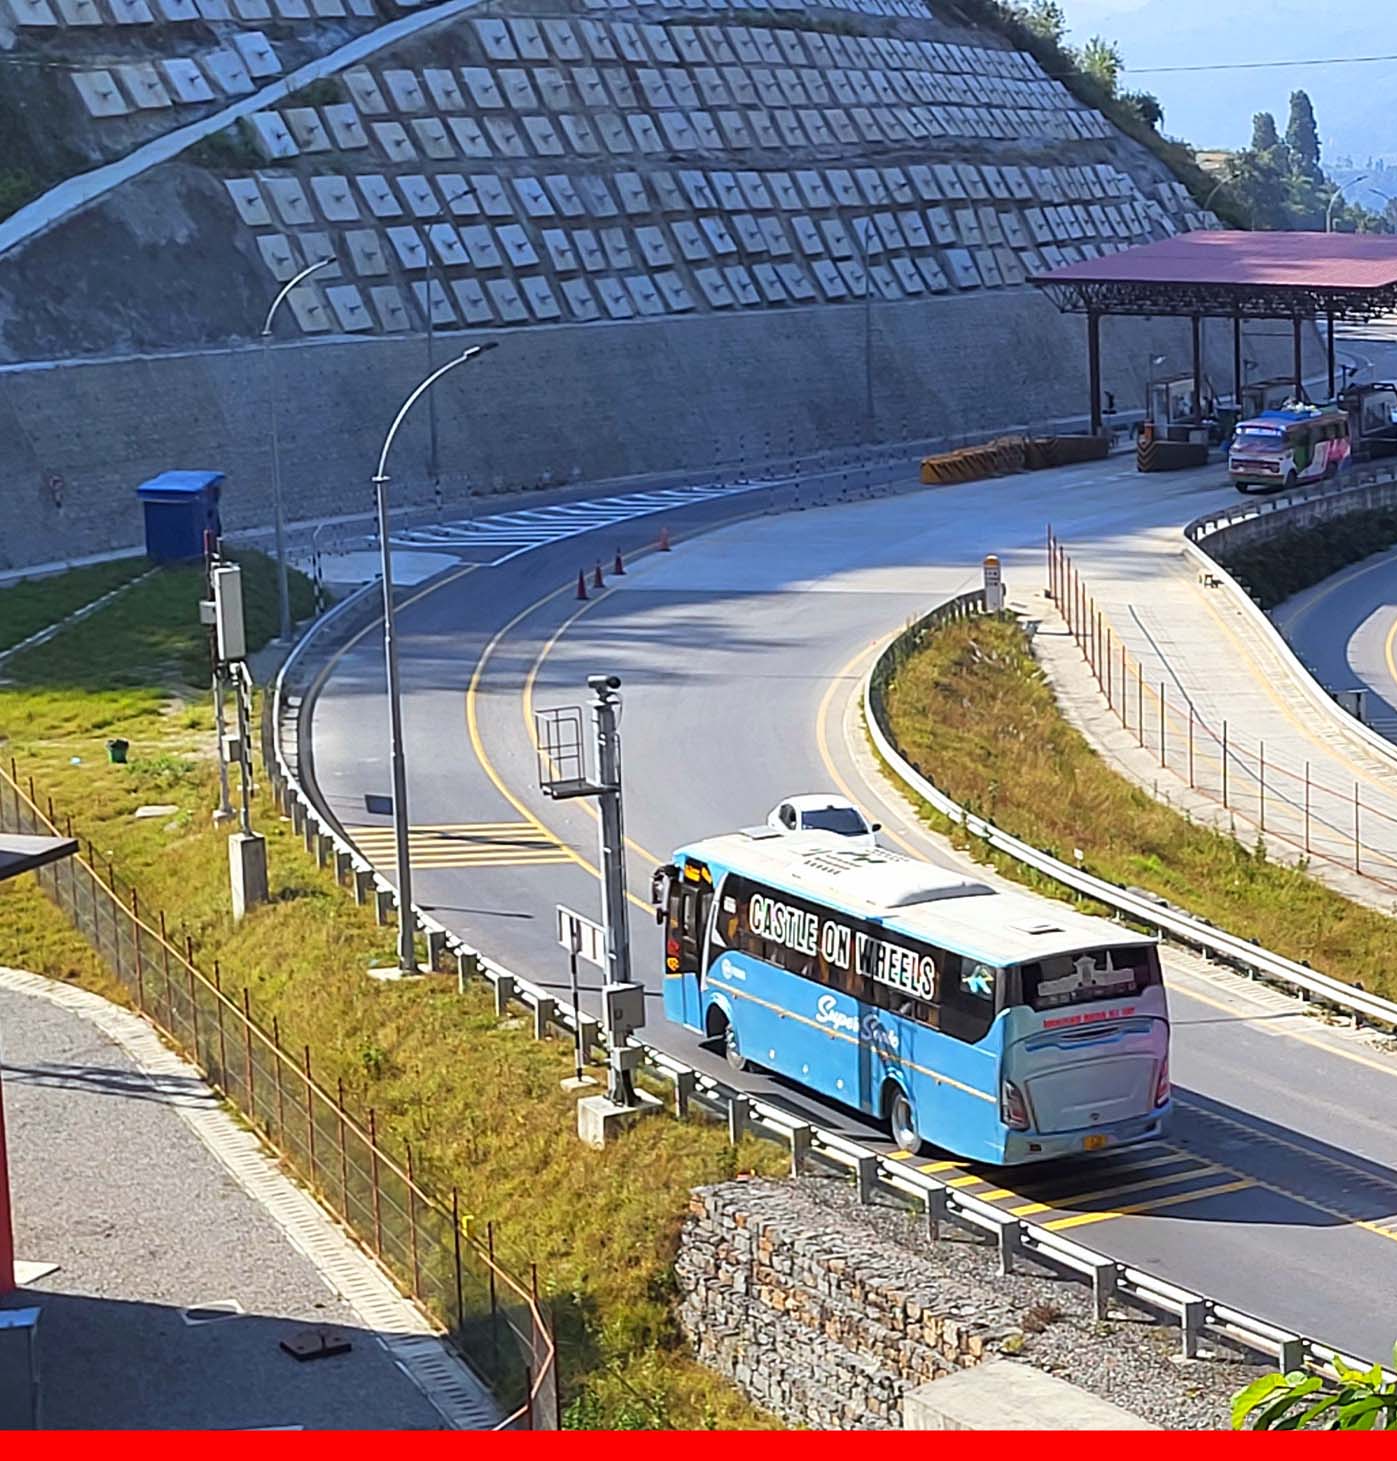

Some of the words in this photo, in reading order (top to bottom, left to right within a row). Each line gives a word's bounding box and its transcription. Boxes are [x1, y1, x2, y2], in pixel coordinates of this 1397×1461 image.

[750, 893, 819, 957] CASTLE
[821, 920, 851, 970] ON
[855, 931, 936, 1001] WHEELS
